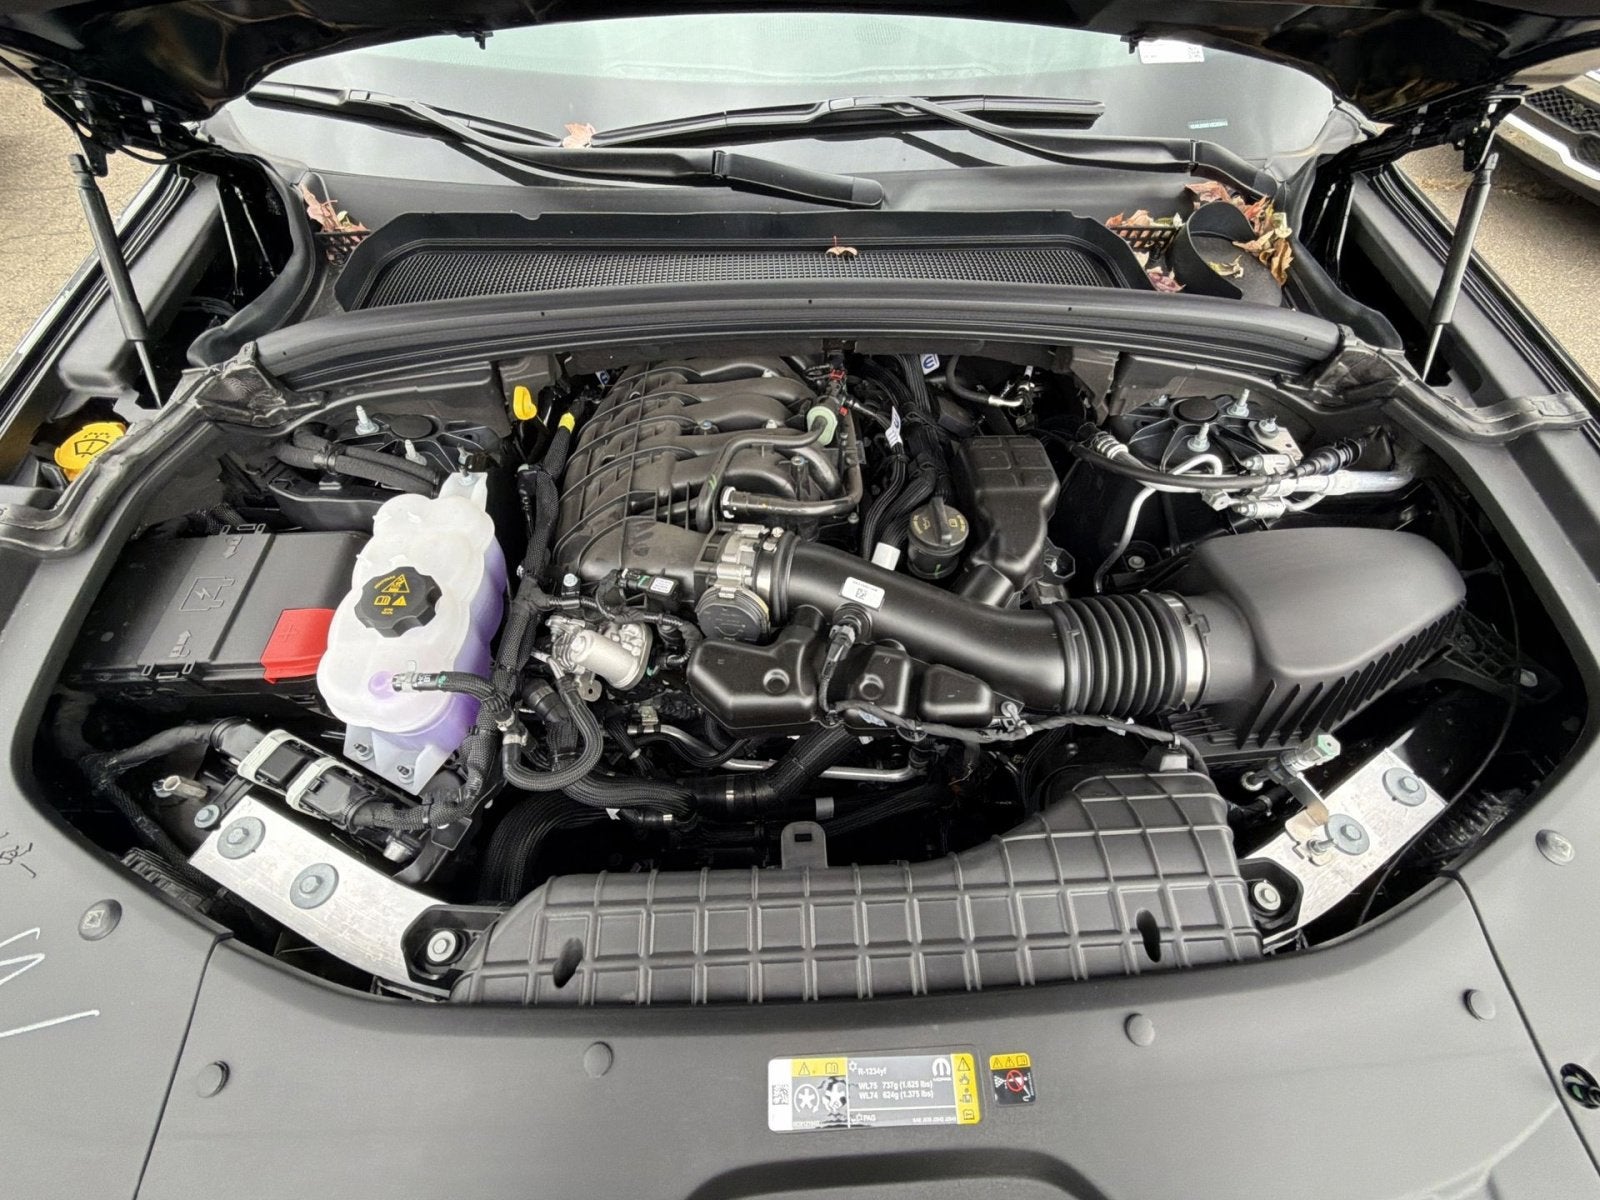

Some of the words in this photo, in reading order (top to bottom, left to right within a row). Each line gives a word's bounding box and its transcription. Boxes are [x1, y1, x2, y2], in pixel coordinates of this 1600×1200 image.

[858, 1067, 887, 1077] R-1234yf
[858, 1082, 878, 1090] WL75
[882, 1081, 899, 1091] 737g
[899, 1080, 920, 1090] (1.625
[920, 1080, 933, 1089] lbs)
[859, 1092, 878, 1100] WL74
[900, 1091, 920, 1100] (1.375
[921, 1090, 933, 1099] lbs)
